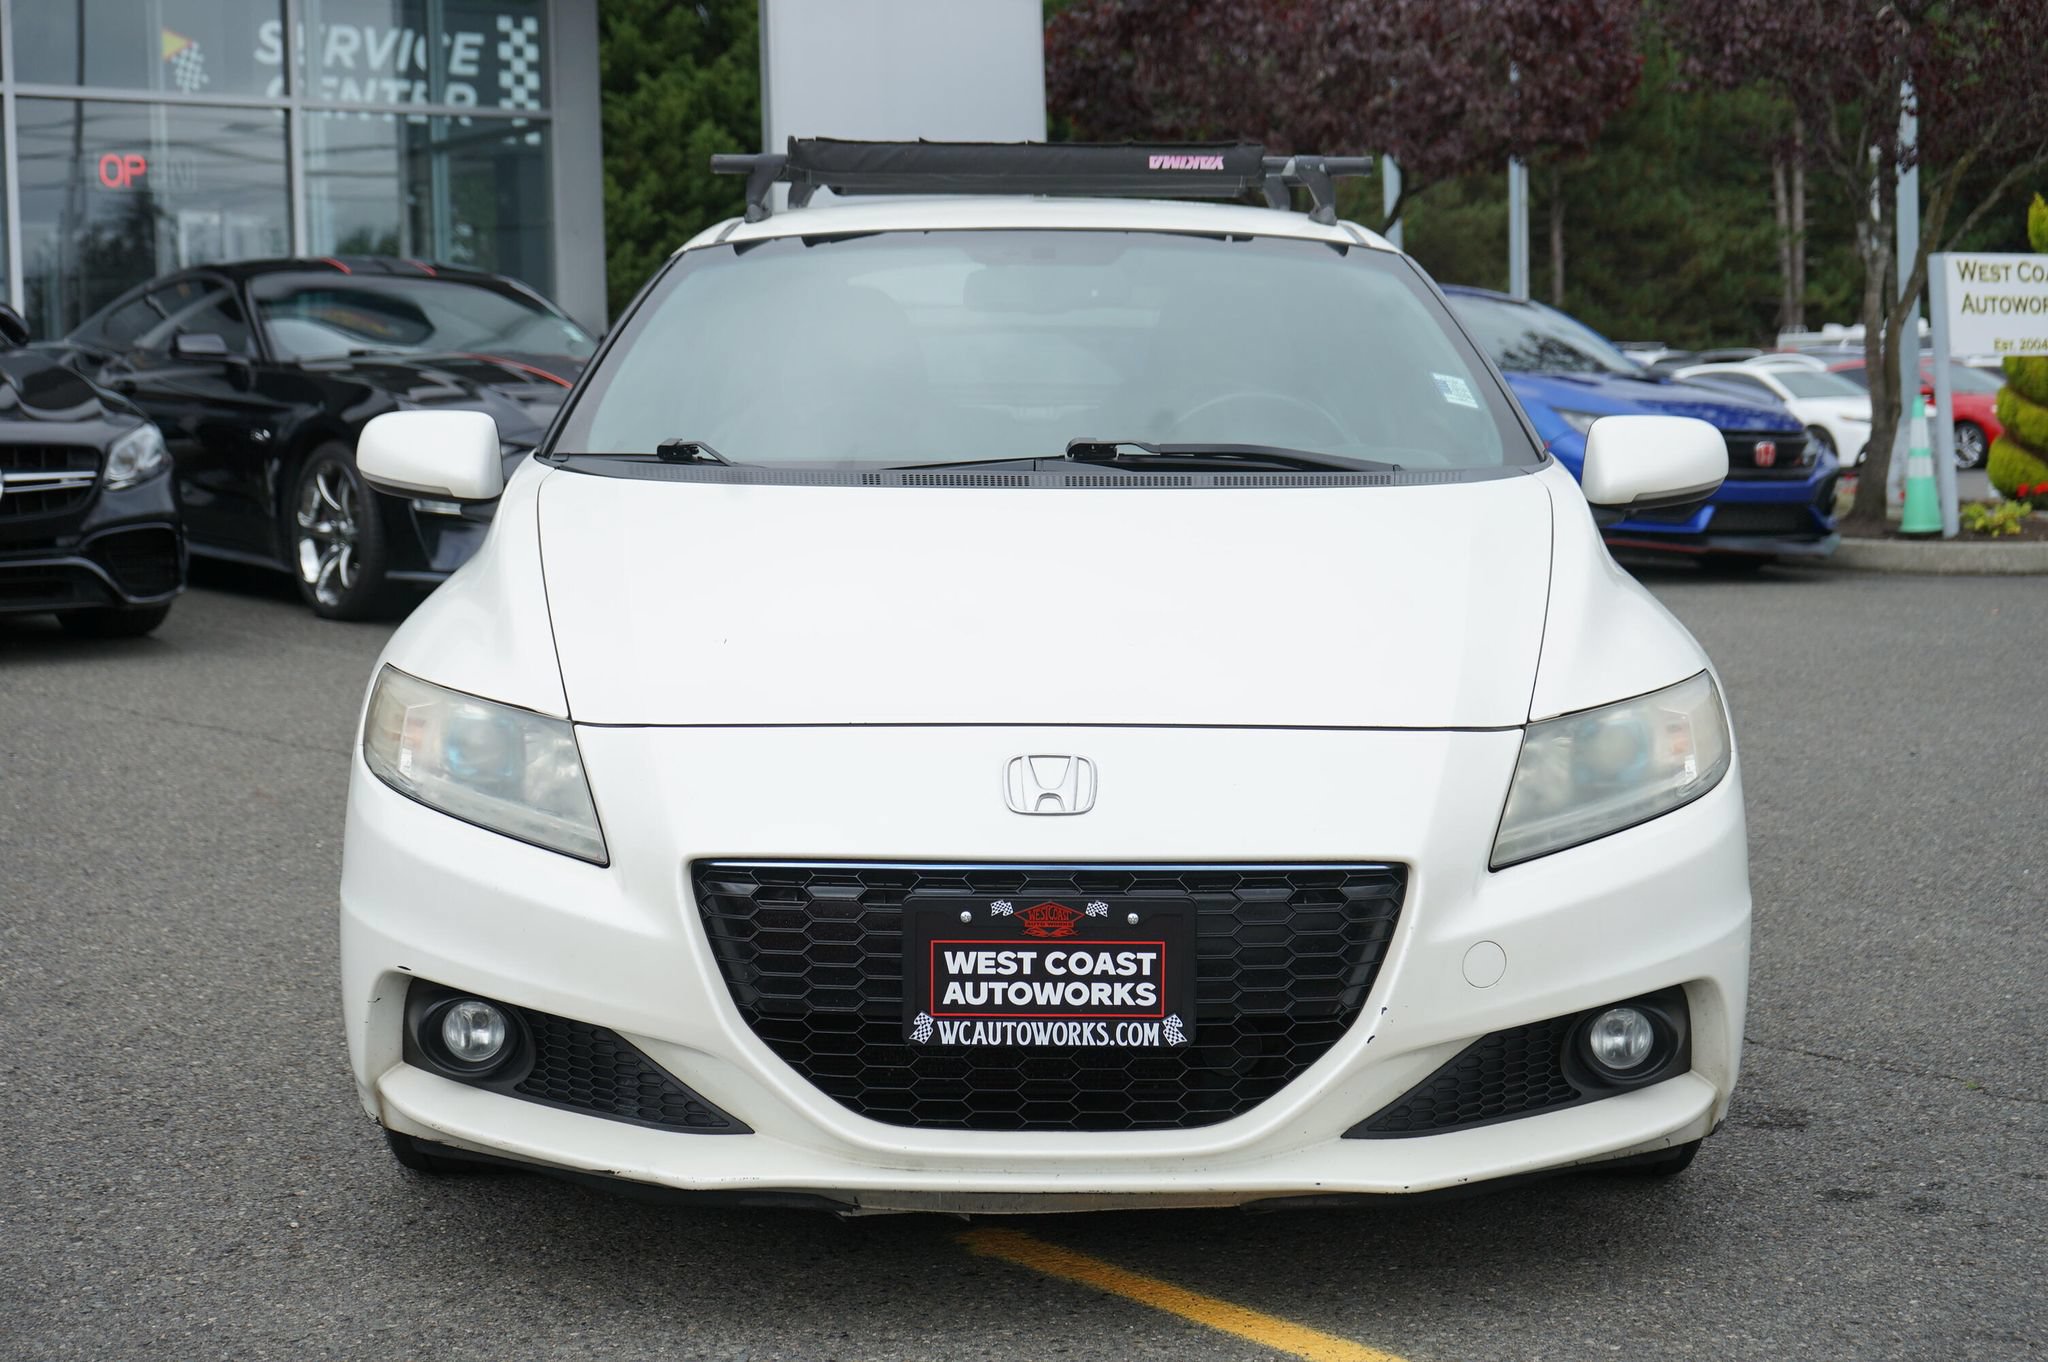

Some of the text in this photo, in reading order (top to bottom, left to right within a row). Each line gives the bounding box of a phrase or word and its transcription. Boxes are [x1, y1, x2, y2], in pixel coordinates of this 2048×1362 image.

[1148, 154, 1224, 171] YAKIMA
[2017, 262, 2048, 283] CO
[944, 951, 1157, 976] WEST COAST
[942, 981, 1157, 1006] AUTOWORKS
[937, 1020, 1160, 1046] WCAUTOWORKS.COM
